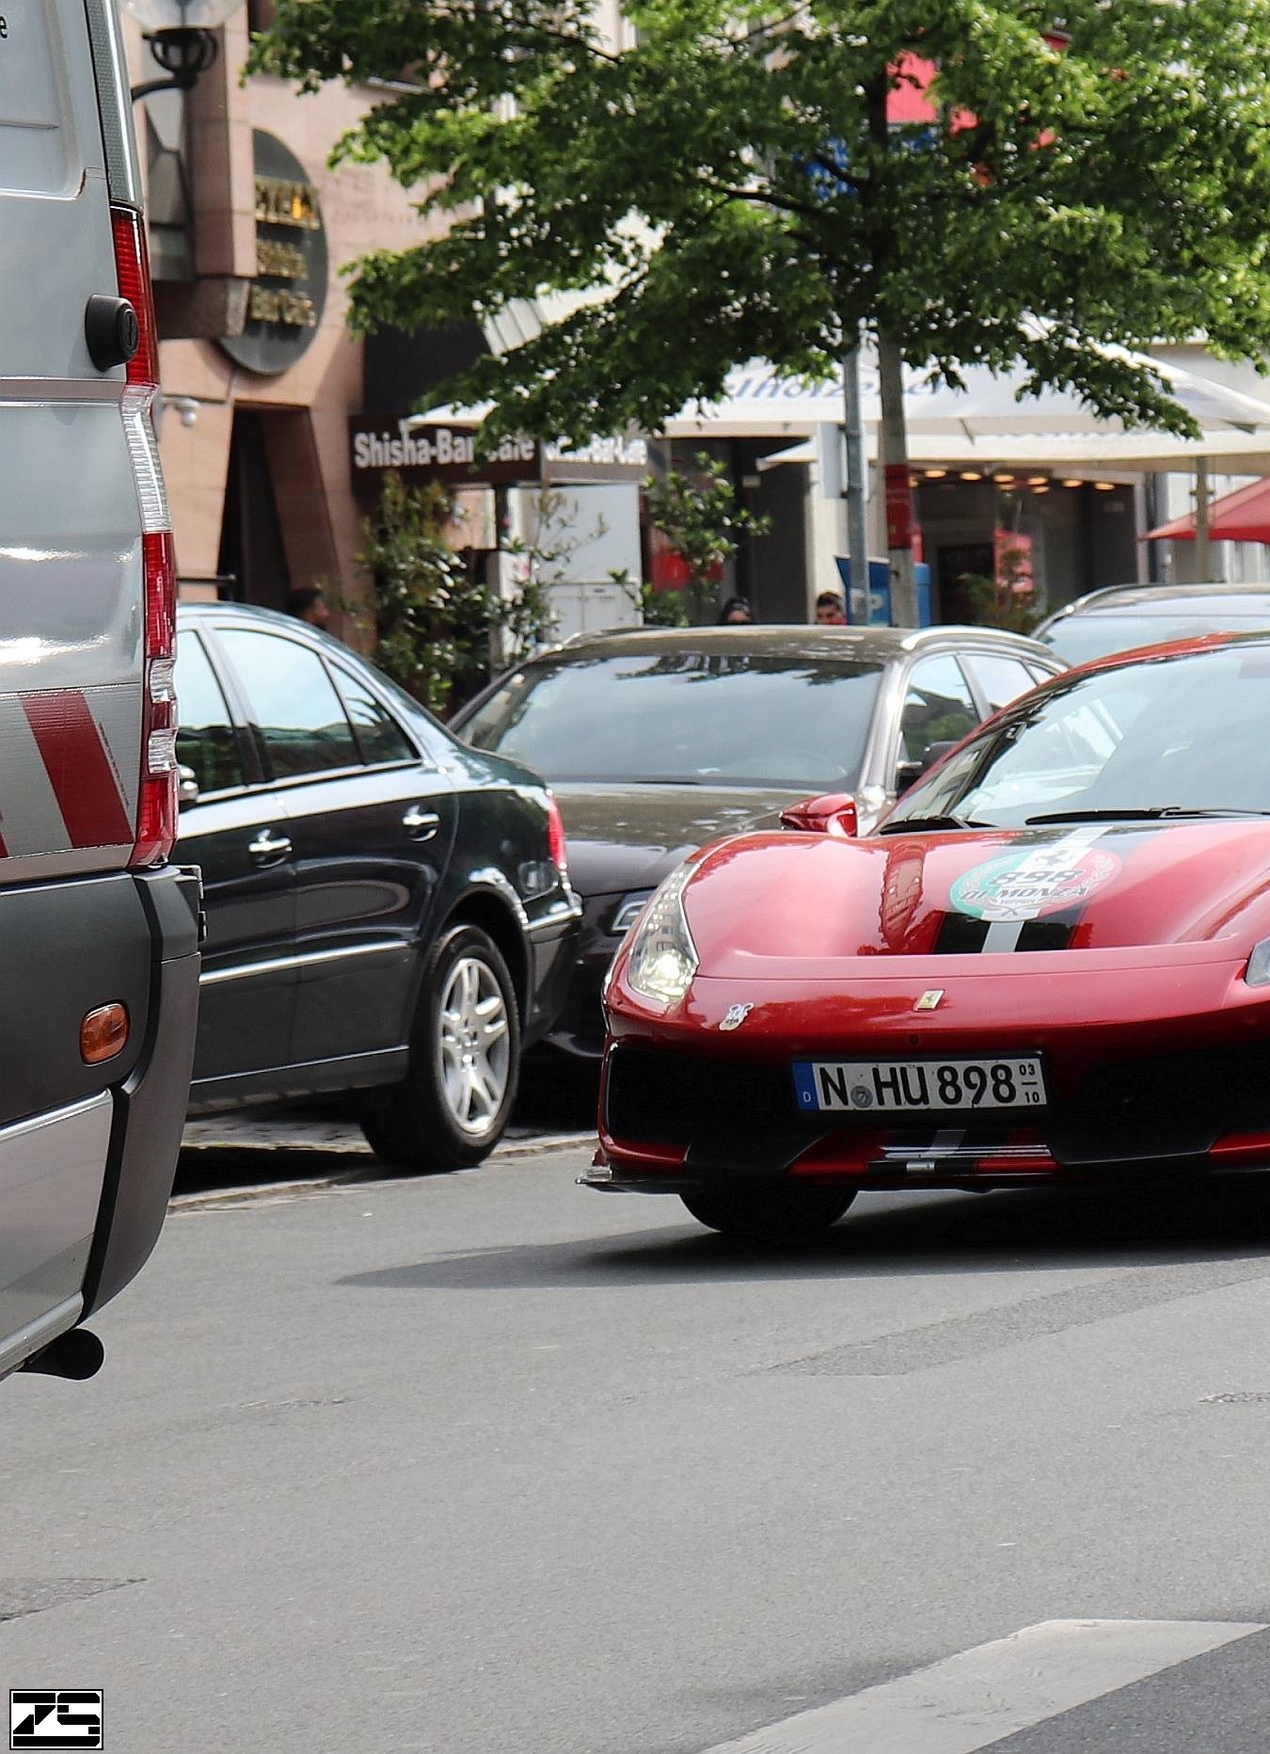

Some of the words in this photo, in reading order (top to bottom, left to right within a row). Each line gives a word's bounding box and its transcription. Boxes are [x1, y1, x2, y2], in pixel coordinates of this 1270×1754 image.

[988, 869, 1085, 887] 898
[960, 890, 987, 901] DI
[1000, 887, 1089, 899] MONZA
[803, 1091, 811, 1103] D
[819, 1067, 849, 1106] N
[872, 1066, 930, 1106] HU
[936, 1063, 1017, 1106] 898
[1019, 1063, 1036, 1076] 03
[1024, 1091, 1040, 1103] 10
